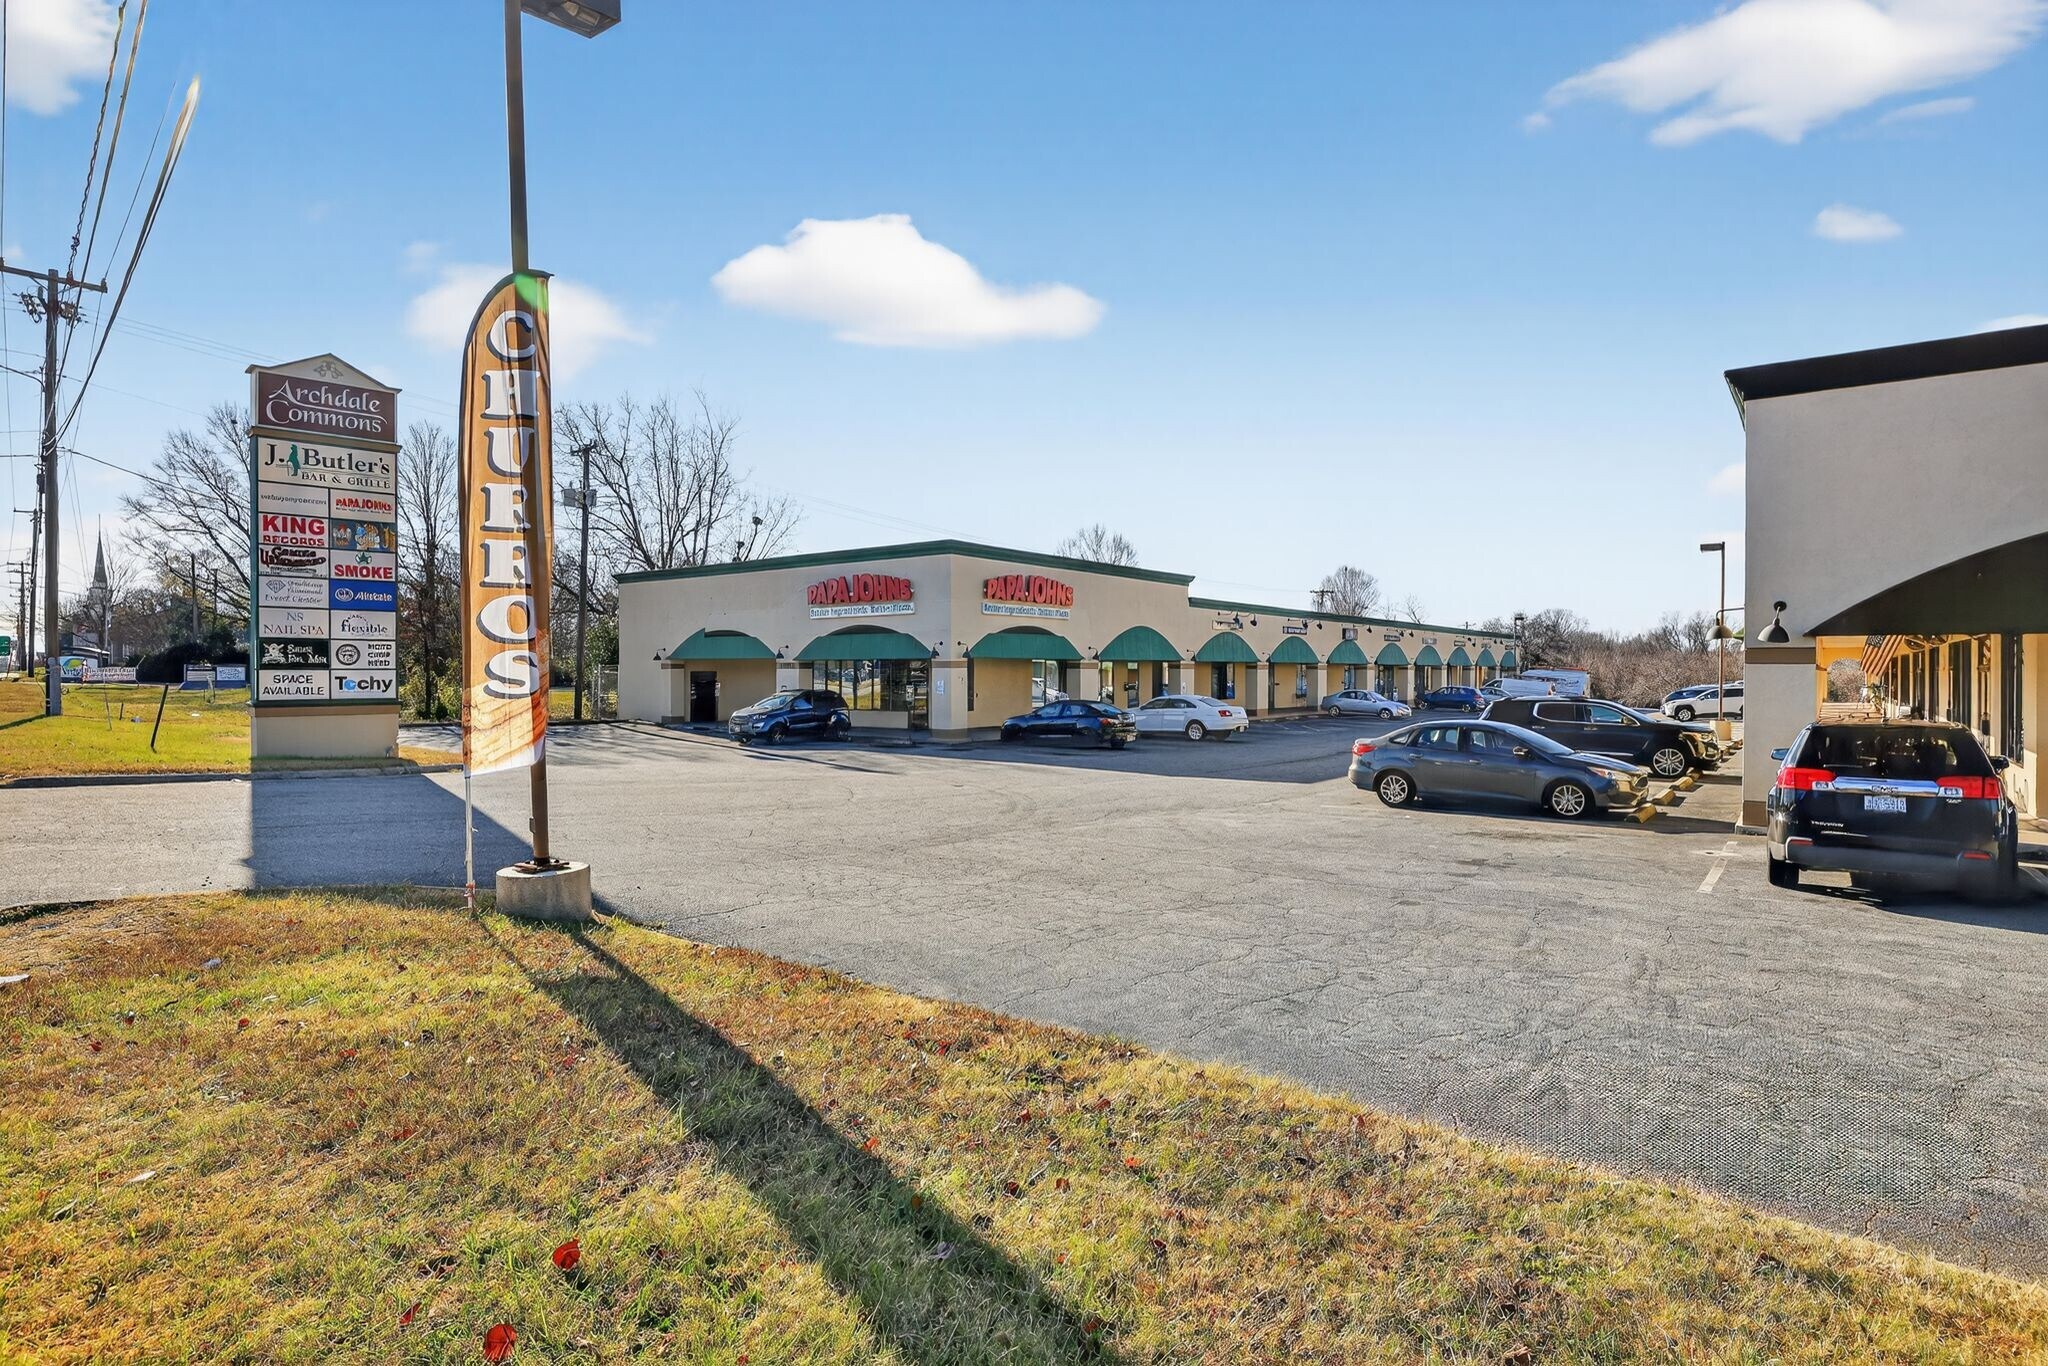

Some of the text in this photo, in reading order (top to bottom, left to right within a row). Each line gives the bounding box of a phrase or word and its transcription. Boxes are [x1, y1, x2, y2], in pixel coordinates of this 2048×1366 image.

[268, 379, 381, 413] Archdale
[266, 399, 382, 433] Commons
[264, 443, 390, 475] J. Butler's
[301, 471, 327, 482] BAR
[347, 477, 391, 489] GRILLE
[479, 310, 541, 699] CHURROS
[262, 514, 325, 535] KING
[262, 535, 325, 546] RECORDS
[334, 564, 393, 579] SMOKE
[807, 576, 849, 605] PAPA
[985, 574, 1074, 606] PAPA JOHNS
[286, 612, 304, 621] NS
[263, 624, 324, 635] NAIL SPA
[341, 619, 388, 633] flexible
[273, 674, 313, 684] SPACE
[262, 686, 325, 696] AVAILABLE
